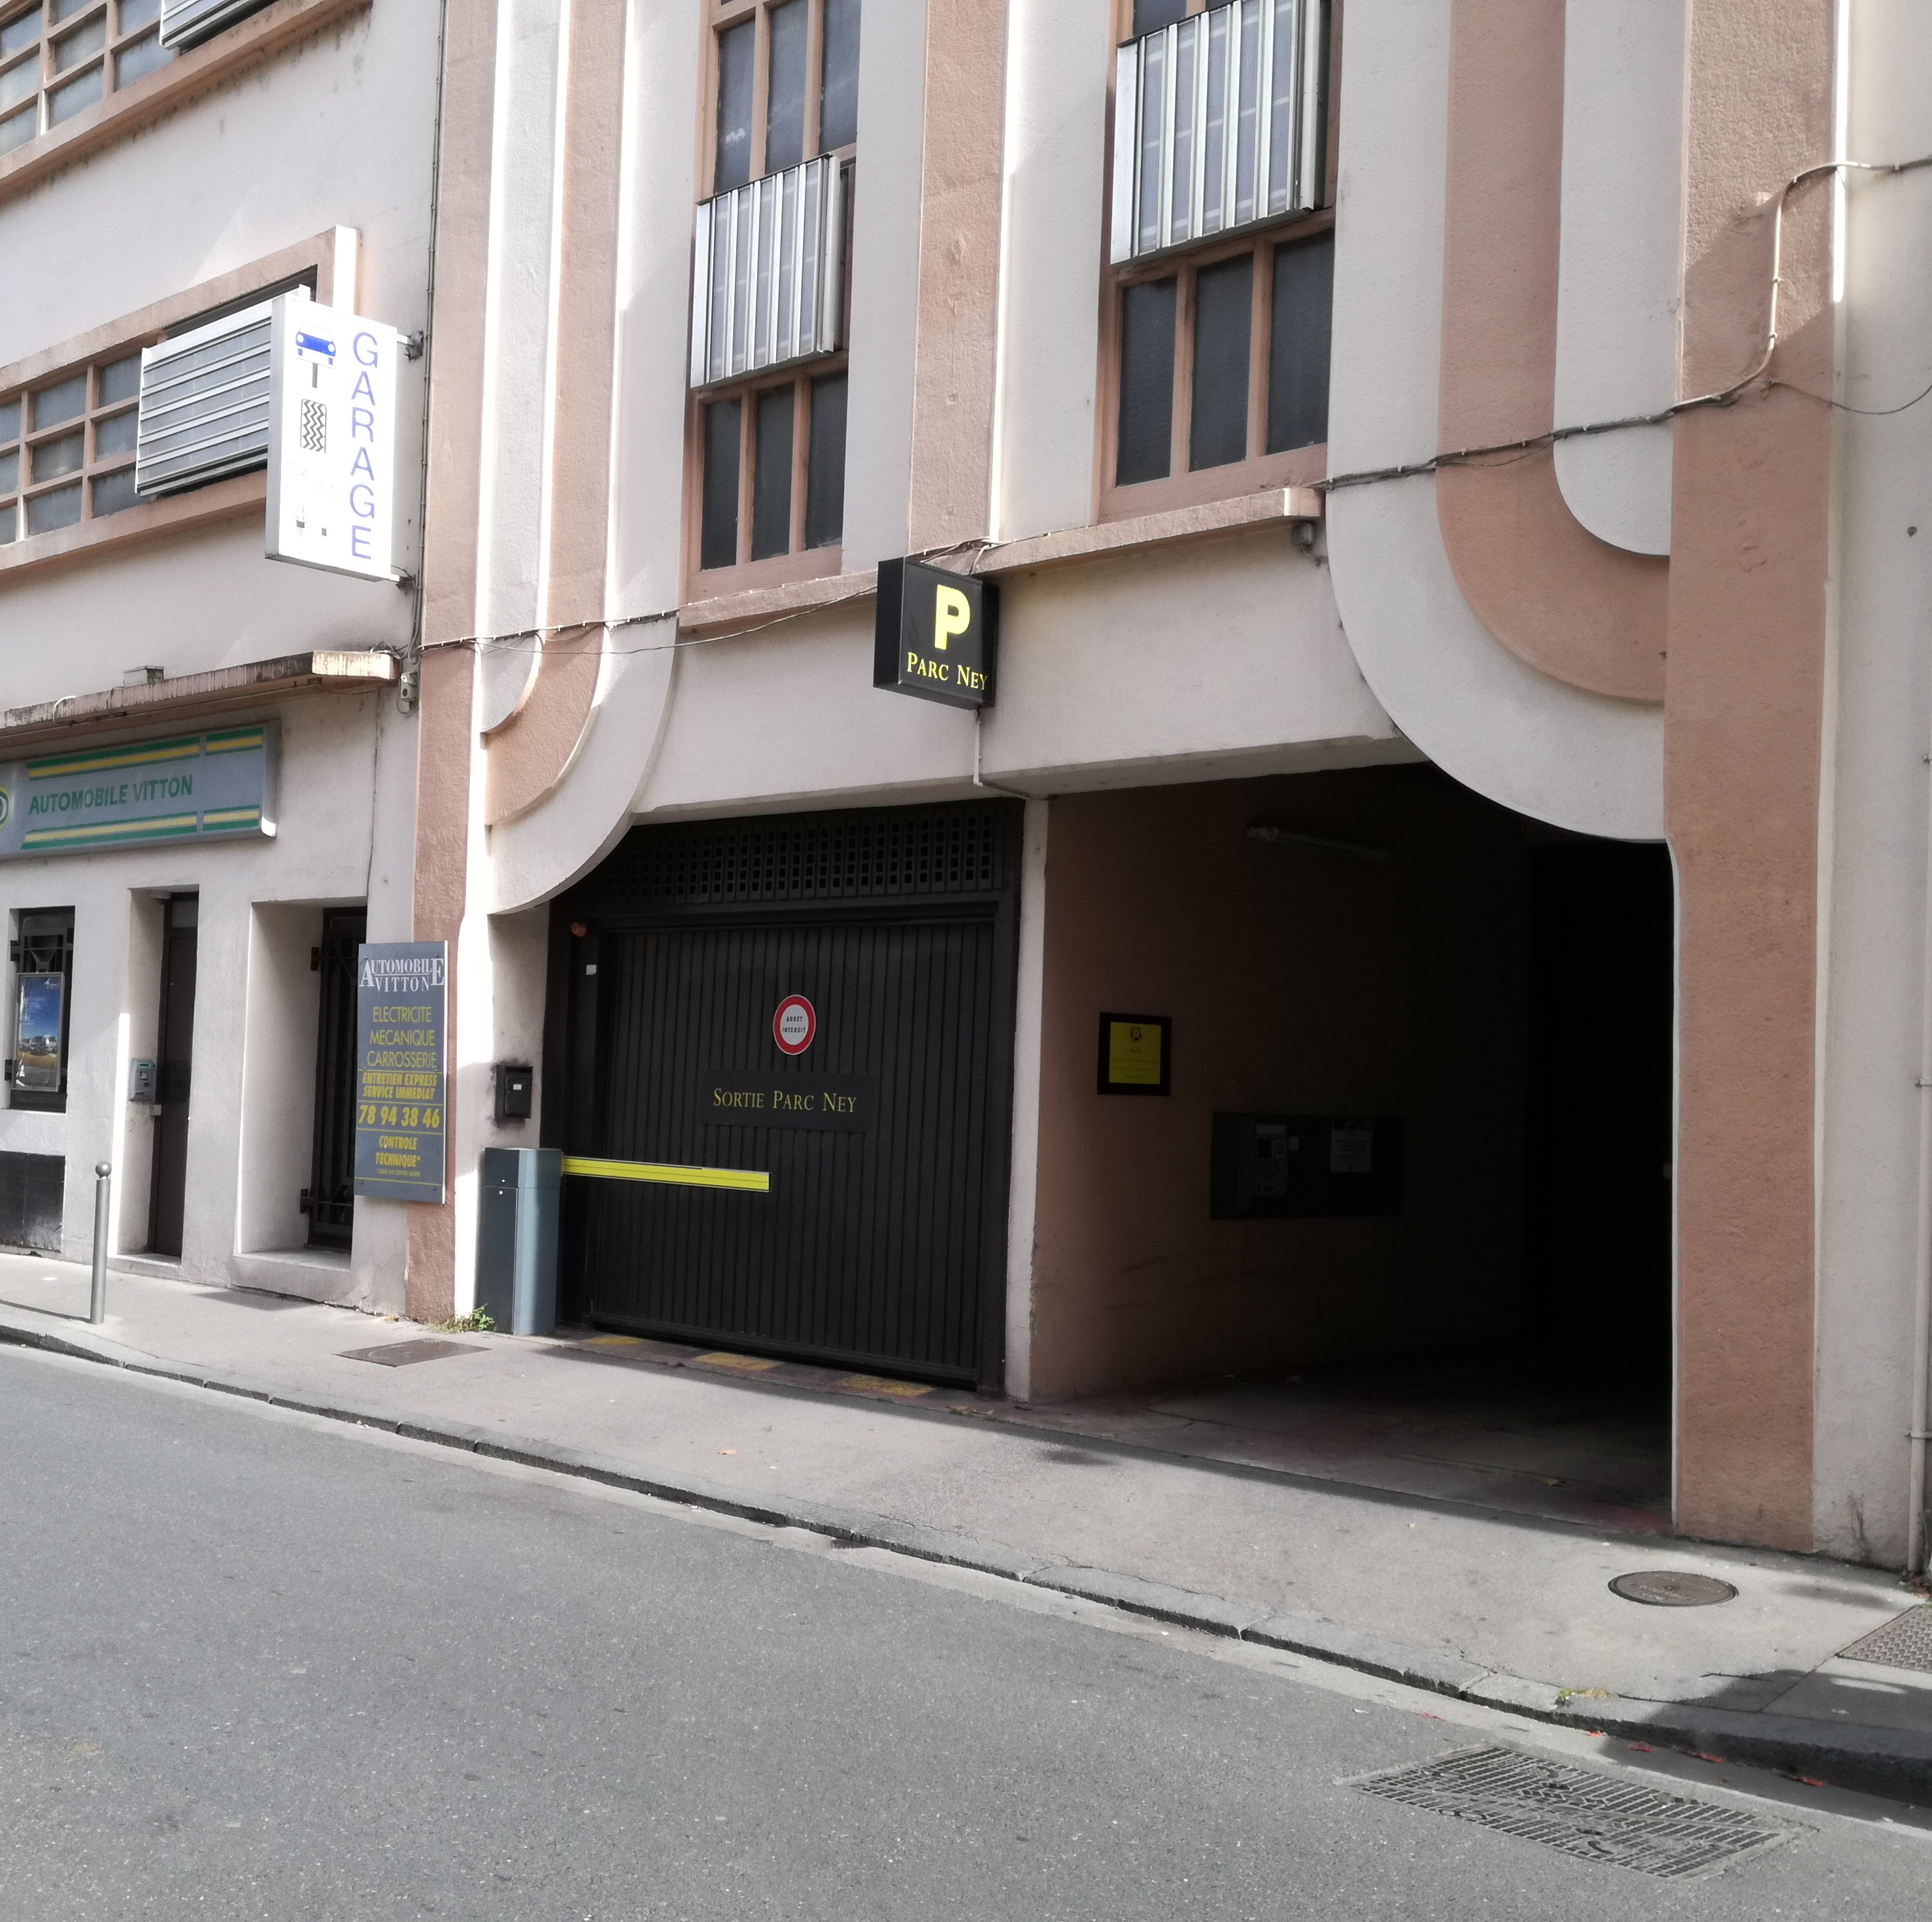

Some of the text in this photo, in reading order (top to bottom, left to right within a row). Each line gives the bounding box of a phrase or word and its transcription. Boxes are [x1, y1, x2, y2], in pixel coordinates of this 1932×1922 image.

[349, 332, 379, 560] GARAGE
[934, 584, 970, 650] P
[906, 651, 988, 691] PARC NEY
[29, 774, 194, 815] AUTOMOBILE VITTON
[359, 958, 445, 987] AUTOMOBILE
[375, 976, 430, 992] VITTON
[373, 1006, 432, 1023] ELECTRICITE
[369, 1029, 435, 1047] MECANIQUE
[367, 1050, 437, 1069] CARROSSERIE
[362, 1073, 437, 1086] ENTRETIEN EXPRESS
[363, 1086, 435, 1100] SERVICE IMMEDIAT
[713, 1088, 858, 1113] SORTIE PARC NEY
[358, 1105, 440, 1129] 78 94 38 46
[379, 1135, 418, 1150] CONTROLE
